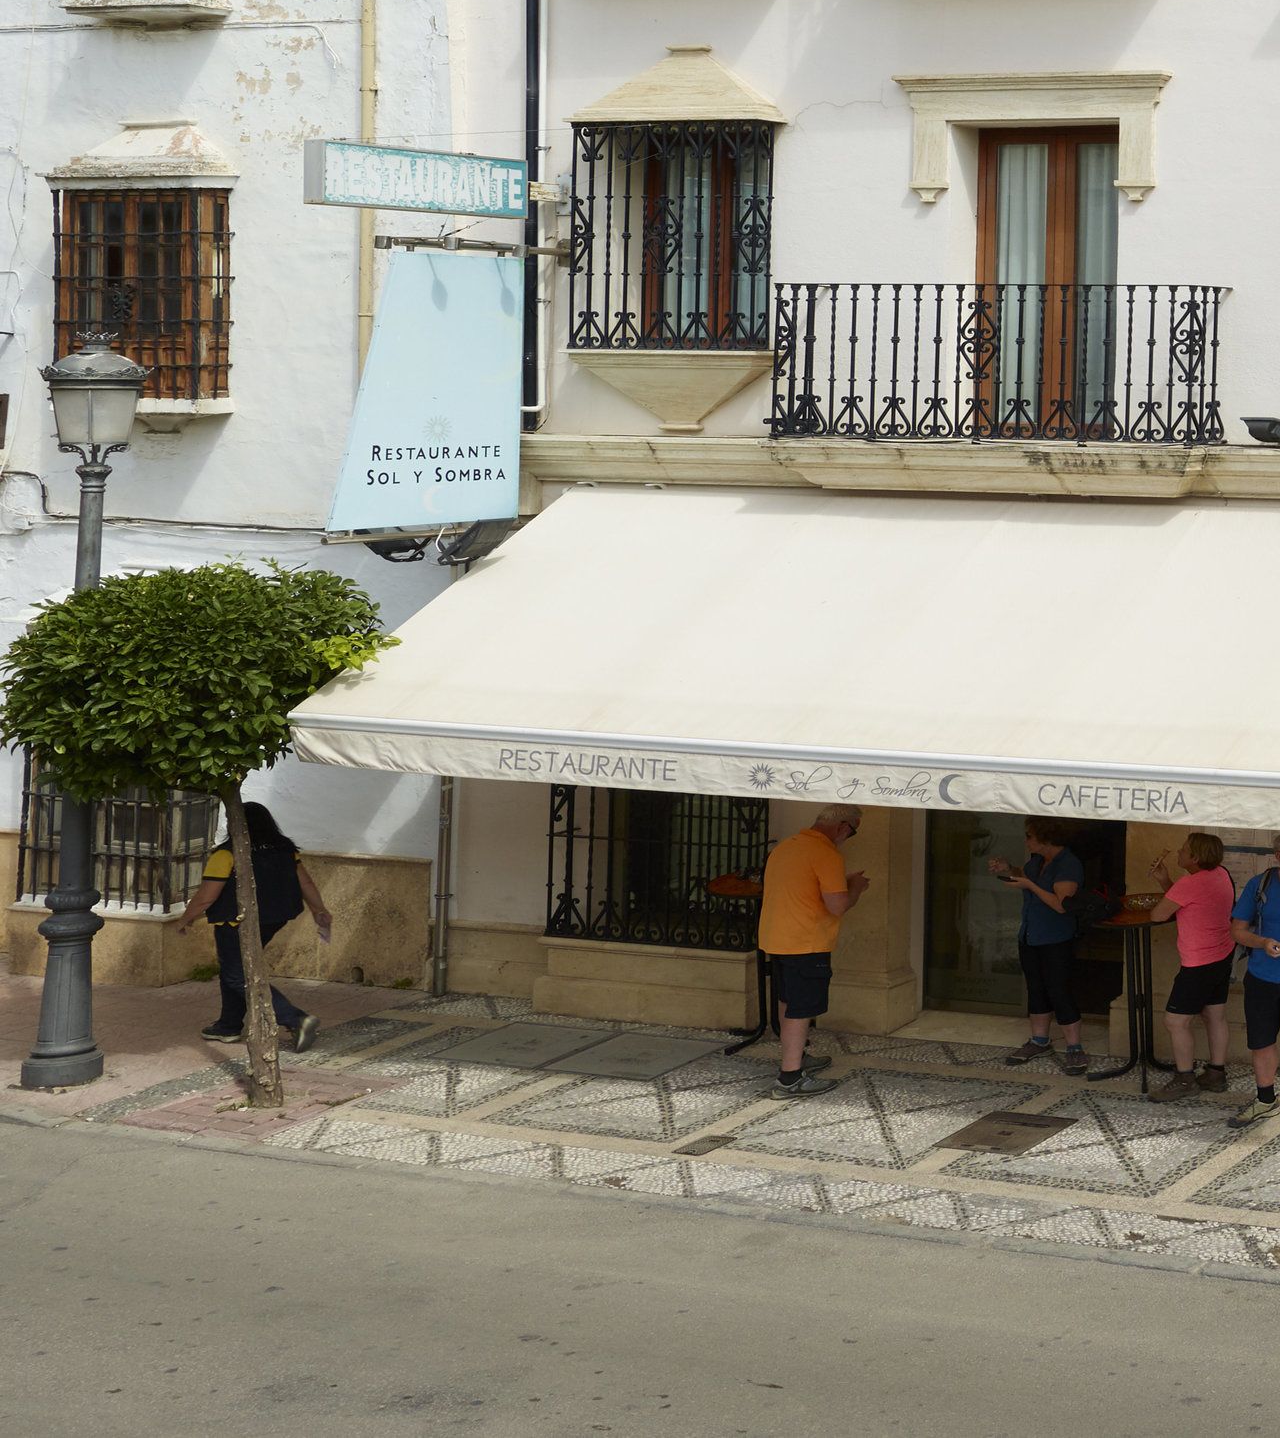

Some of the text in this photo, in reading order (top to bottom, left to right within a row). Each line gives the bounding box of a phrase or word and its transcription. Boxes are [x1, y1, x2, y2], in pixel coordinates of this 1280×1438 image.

[325, 148, 523, 210] RESTAURANTE
[371, 445, 500, 461] RESTAURANTE
[367, 467, 506, 485] SOL Y SOMBRA
[499, 748, 1189, 814] RESTAURANTE Sol y Sombra CAFETERÍA
